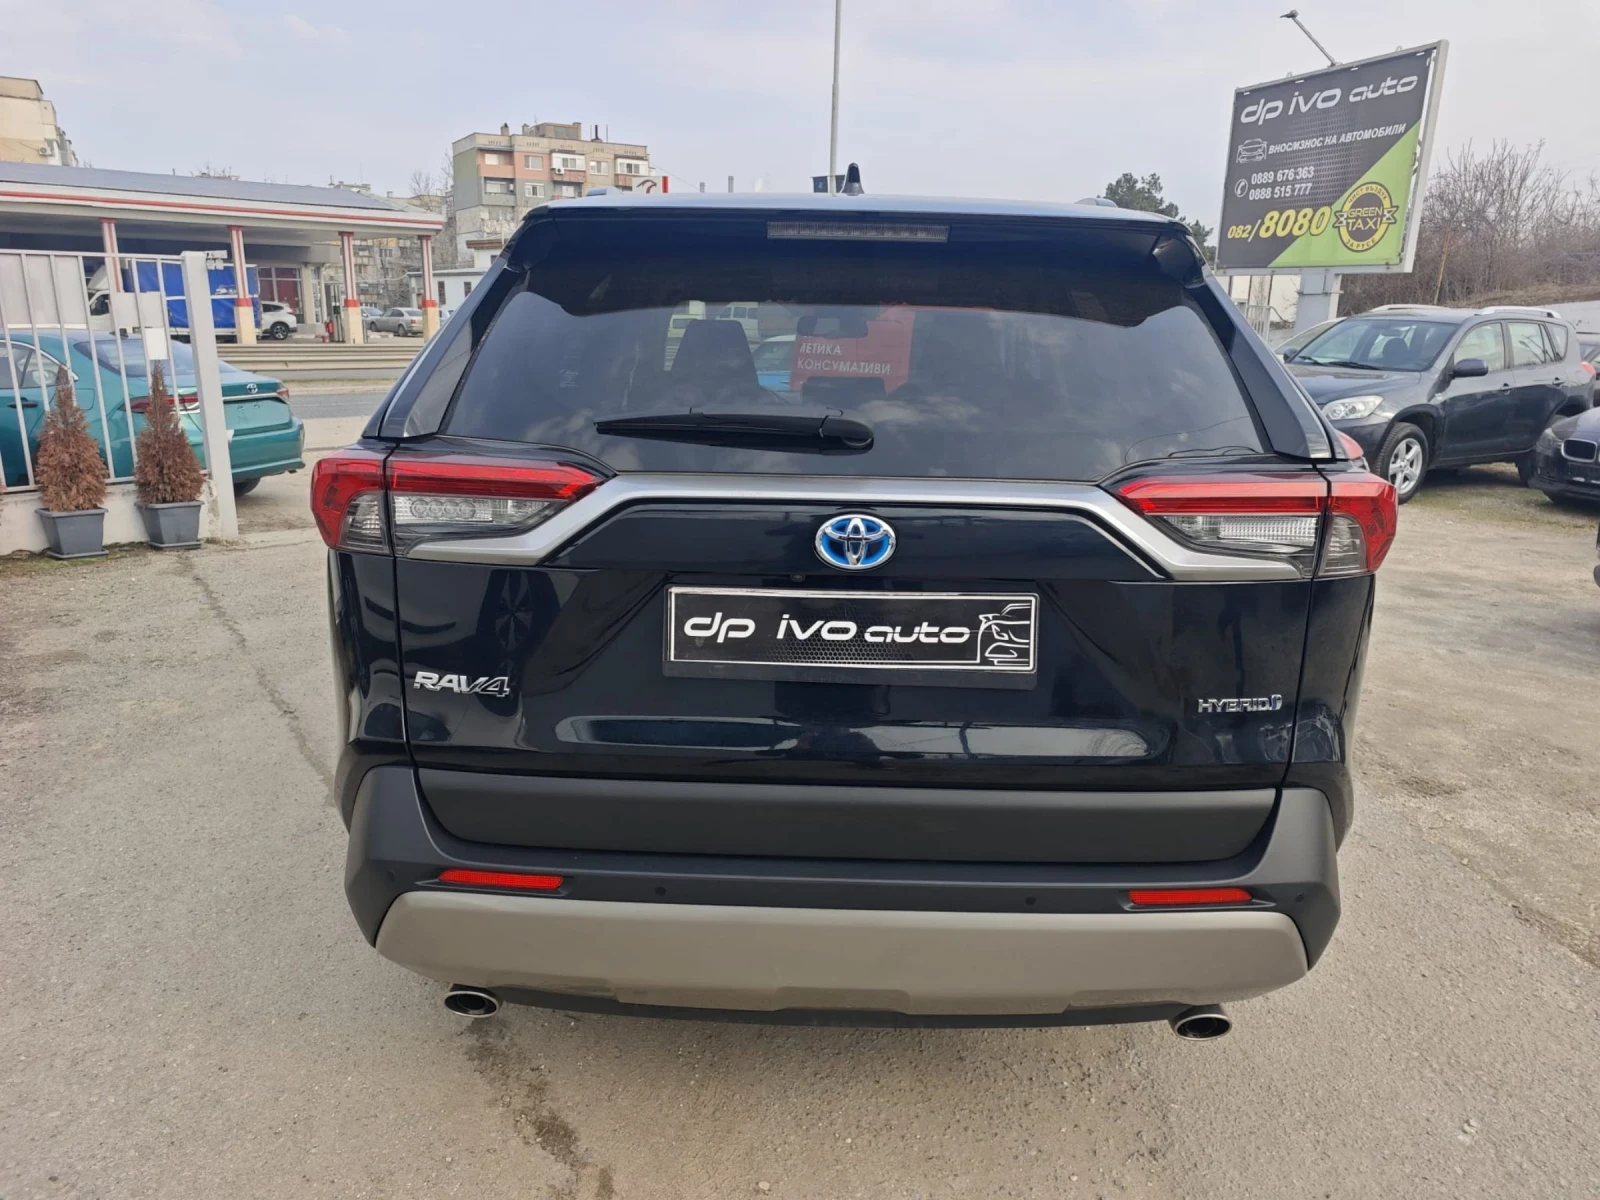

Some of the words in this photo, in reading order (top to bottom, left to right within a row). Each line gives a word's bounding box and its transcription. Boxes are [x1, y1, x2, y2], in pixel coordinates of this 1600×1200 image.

[1240, 99, 1283, 125] dp
[1288, 88, 1341, 115] ivo
[1349, 75, 1418, 102] auto
[1324, 135, 1337, 146] НА
[1339, 123, 1407, 144] АВТОМОБИЛИ
[1251, 172, 1273, 185] 0889
[1277, 169, 1294, 181] 676
[1296, 166, 1314, 179] 363
[1249, 187, 1271, 200] 0888
[1274, 186, 1291, 198] 515
[1294, 183, 1313, 196] 777
[1348, 207, 1383, 218] GREEN
[1347, 217, 1381, 231] TAXI
[797, 357, 891, 375] КОНСУМАТИВИ
[683, 611, 756, 643] dp
[776, 614, 858, 641] ivo
[864, 621, 971, 643] auto
[413, 671, 510, 697] RAV4
[1198, 698, 1271, 713] HYBRID
